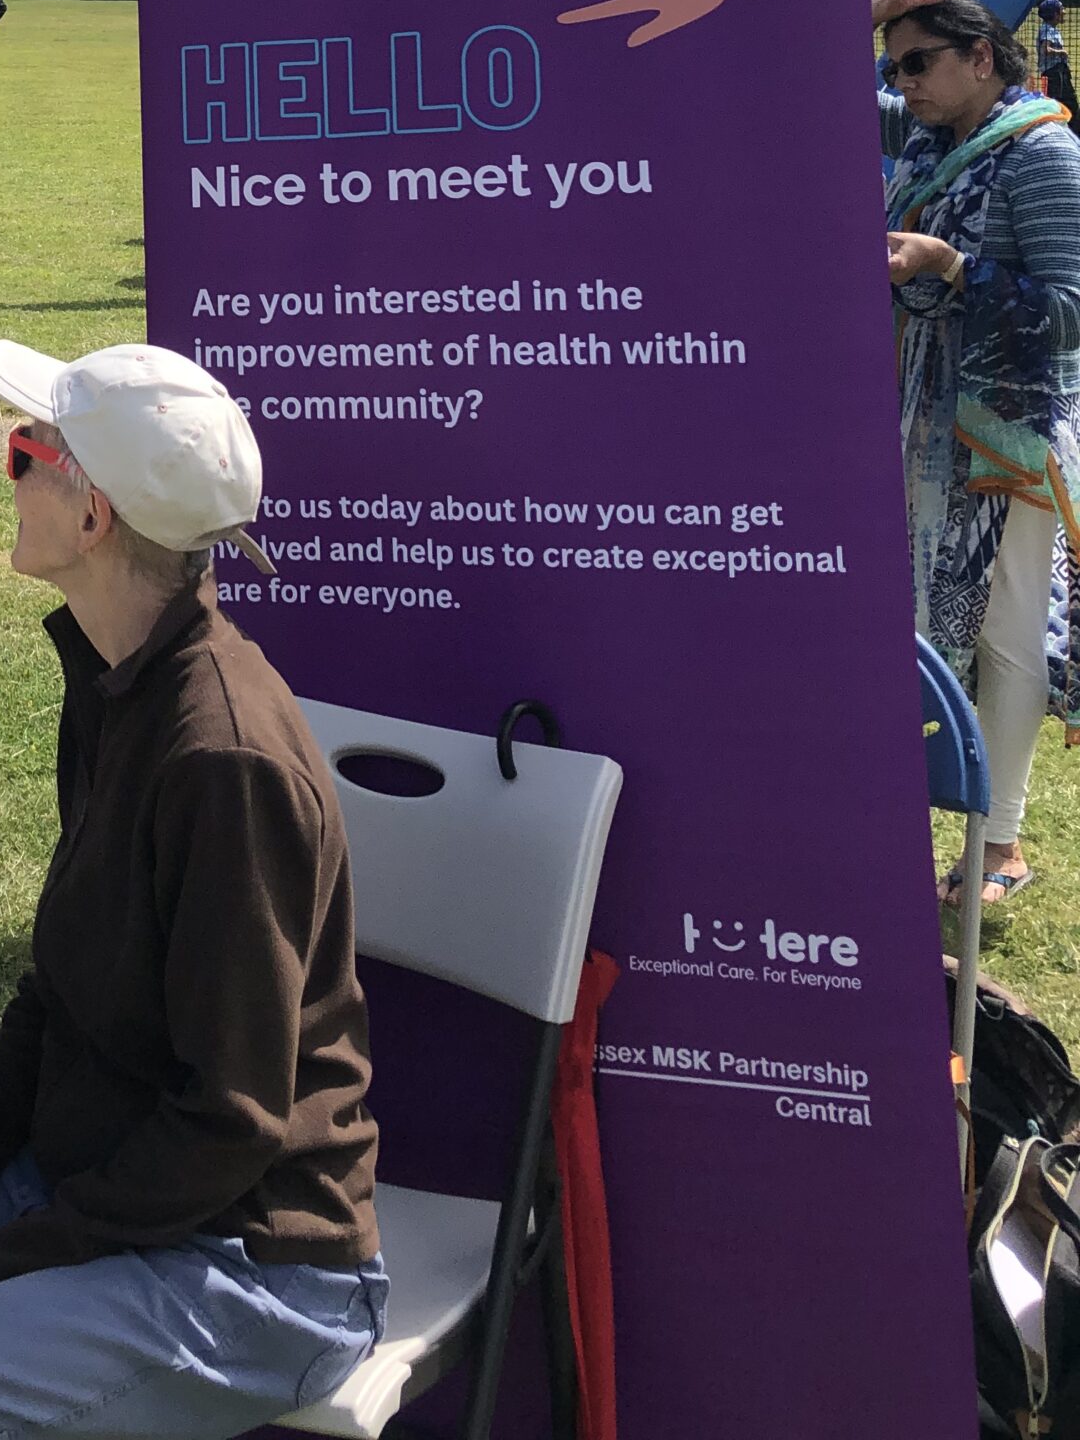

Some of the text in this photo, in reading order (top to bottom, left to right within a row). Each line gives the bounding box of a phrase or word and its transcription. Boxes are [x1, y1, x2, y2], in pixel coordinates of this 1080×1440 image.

[181, 24, 541, 145] HELLO
[190, 154, 653, 209] Nice to meet you
[192, 278, 643, 324] Are you interested in the
[194, 330, 747, 376] improvement of health within
[261, 388, 484, 428] community?
[261, 493, 784, 533] to us today about how you can get
[209, 534, 847, 578] nvlved and help us to create exceptional
[217, 577, 462, 613] are for everyone.
[629, 955, 862, 991] Exceptional Care. For Everyone
[593, 1044, 869, 1092] ssex MSK Partnership
[775, 1095, 872, 1127] Central
